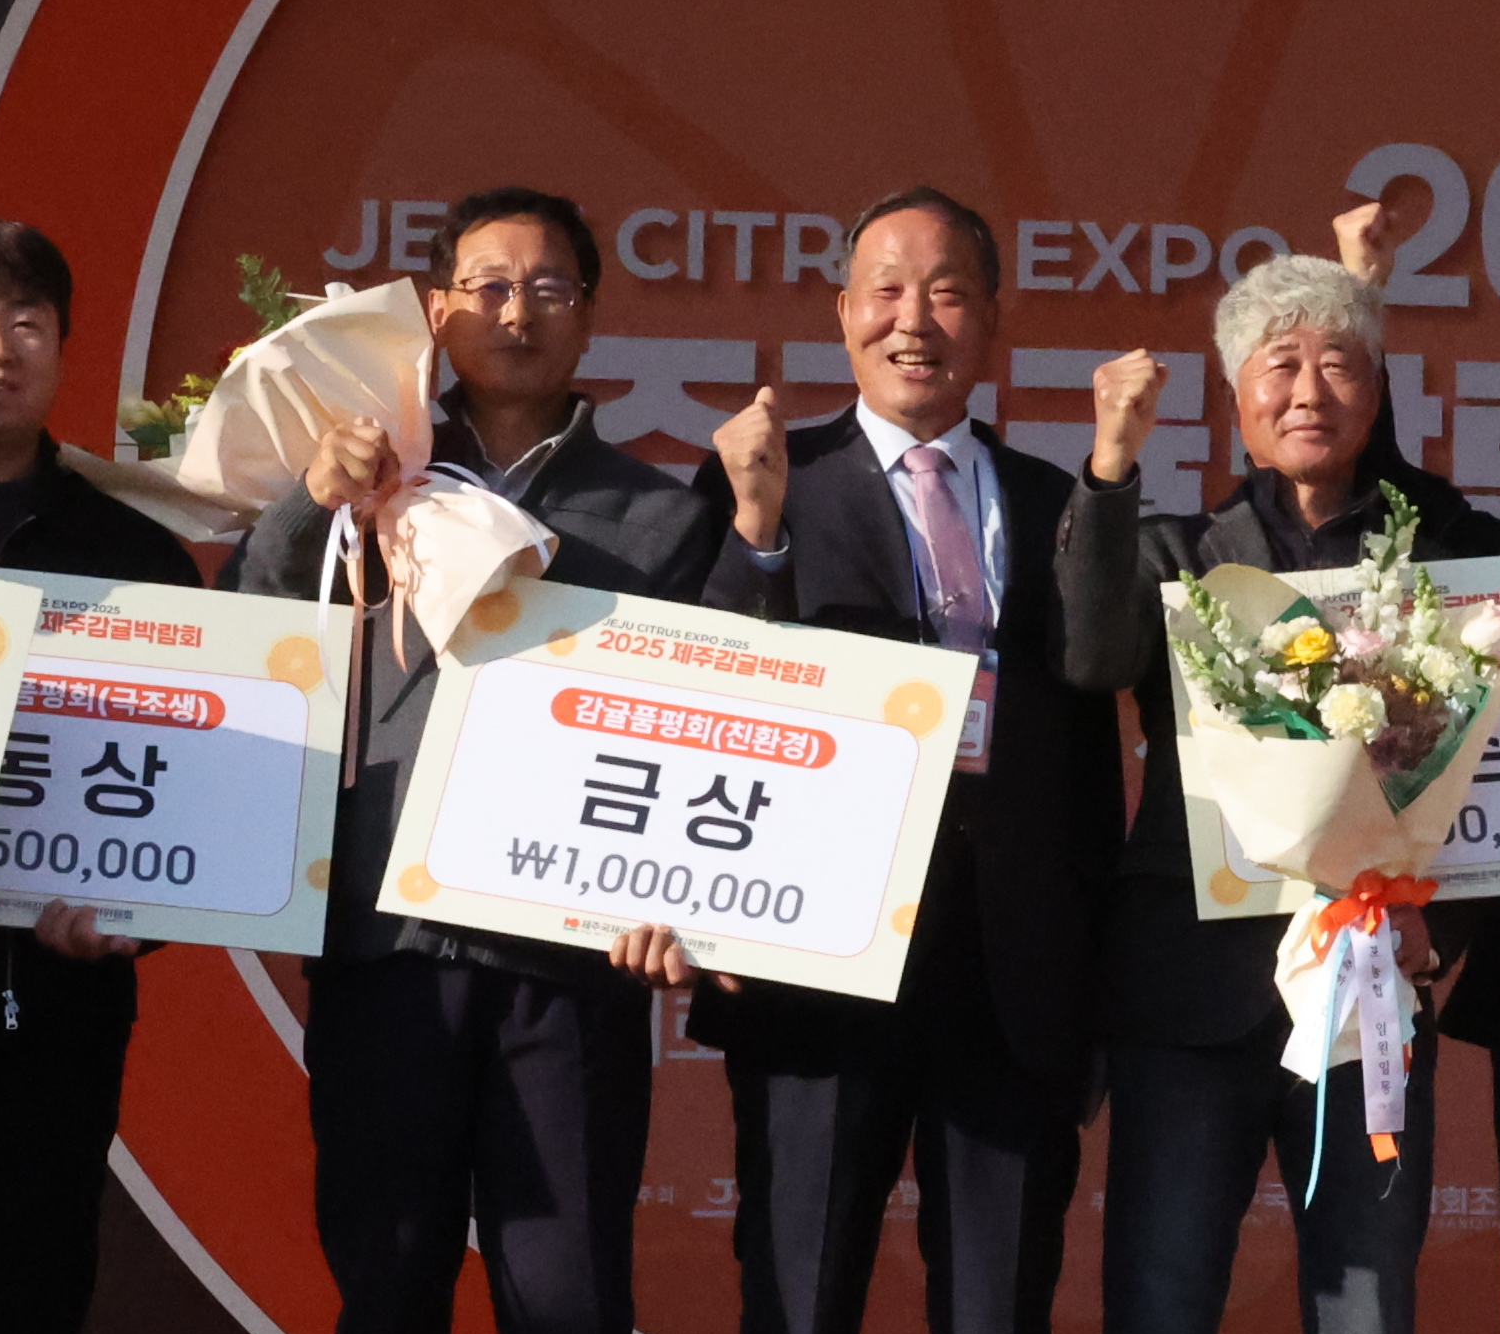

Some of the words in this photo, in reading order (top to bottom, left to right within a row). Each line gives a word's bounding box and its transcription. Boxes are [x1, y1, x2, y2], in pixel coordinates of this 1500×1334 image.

[52, 599, 89, 612] EXPO
[92, 602, 121, 615] 2025
[40, 610, 203, 648] 제주감귤박람회
[602, 617, 635, 631] JEJU
[637, 622, 681, 639] CITRUS
[685, 631, 719, 645] EXPO
[722, 637, 750, 650] 2025
[596, 629, 666, 659] 2025
[669, 641, 827, 688] 제주감귤박람회
[574, 694, 820, 766] 감귤품평회(친환경)
